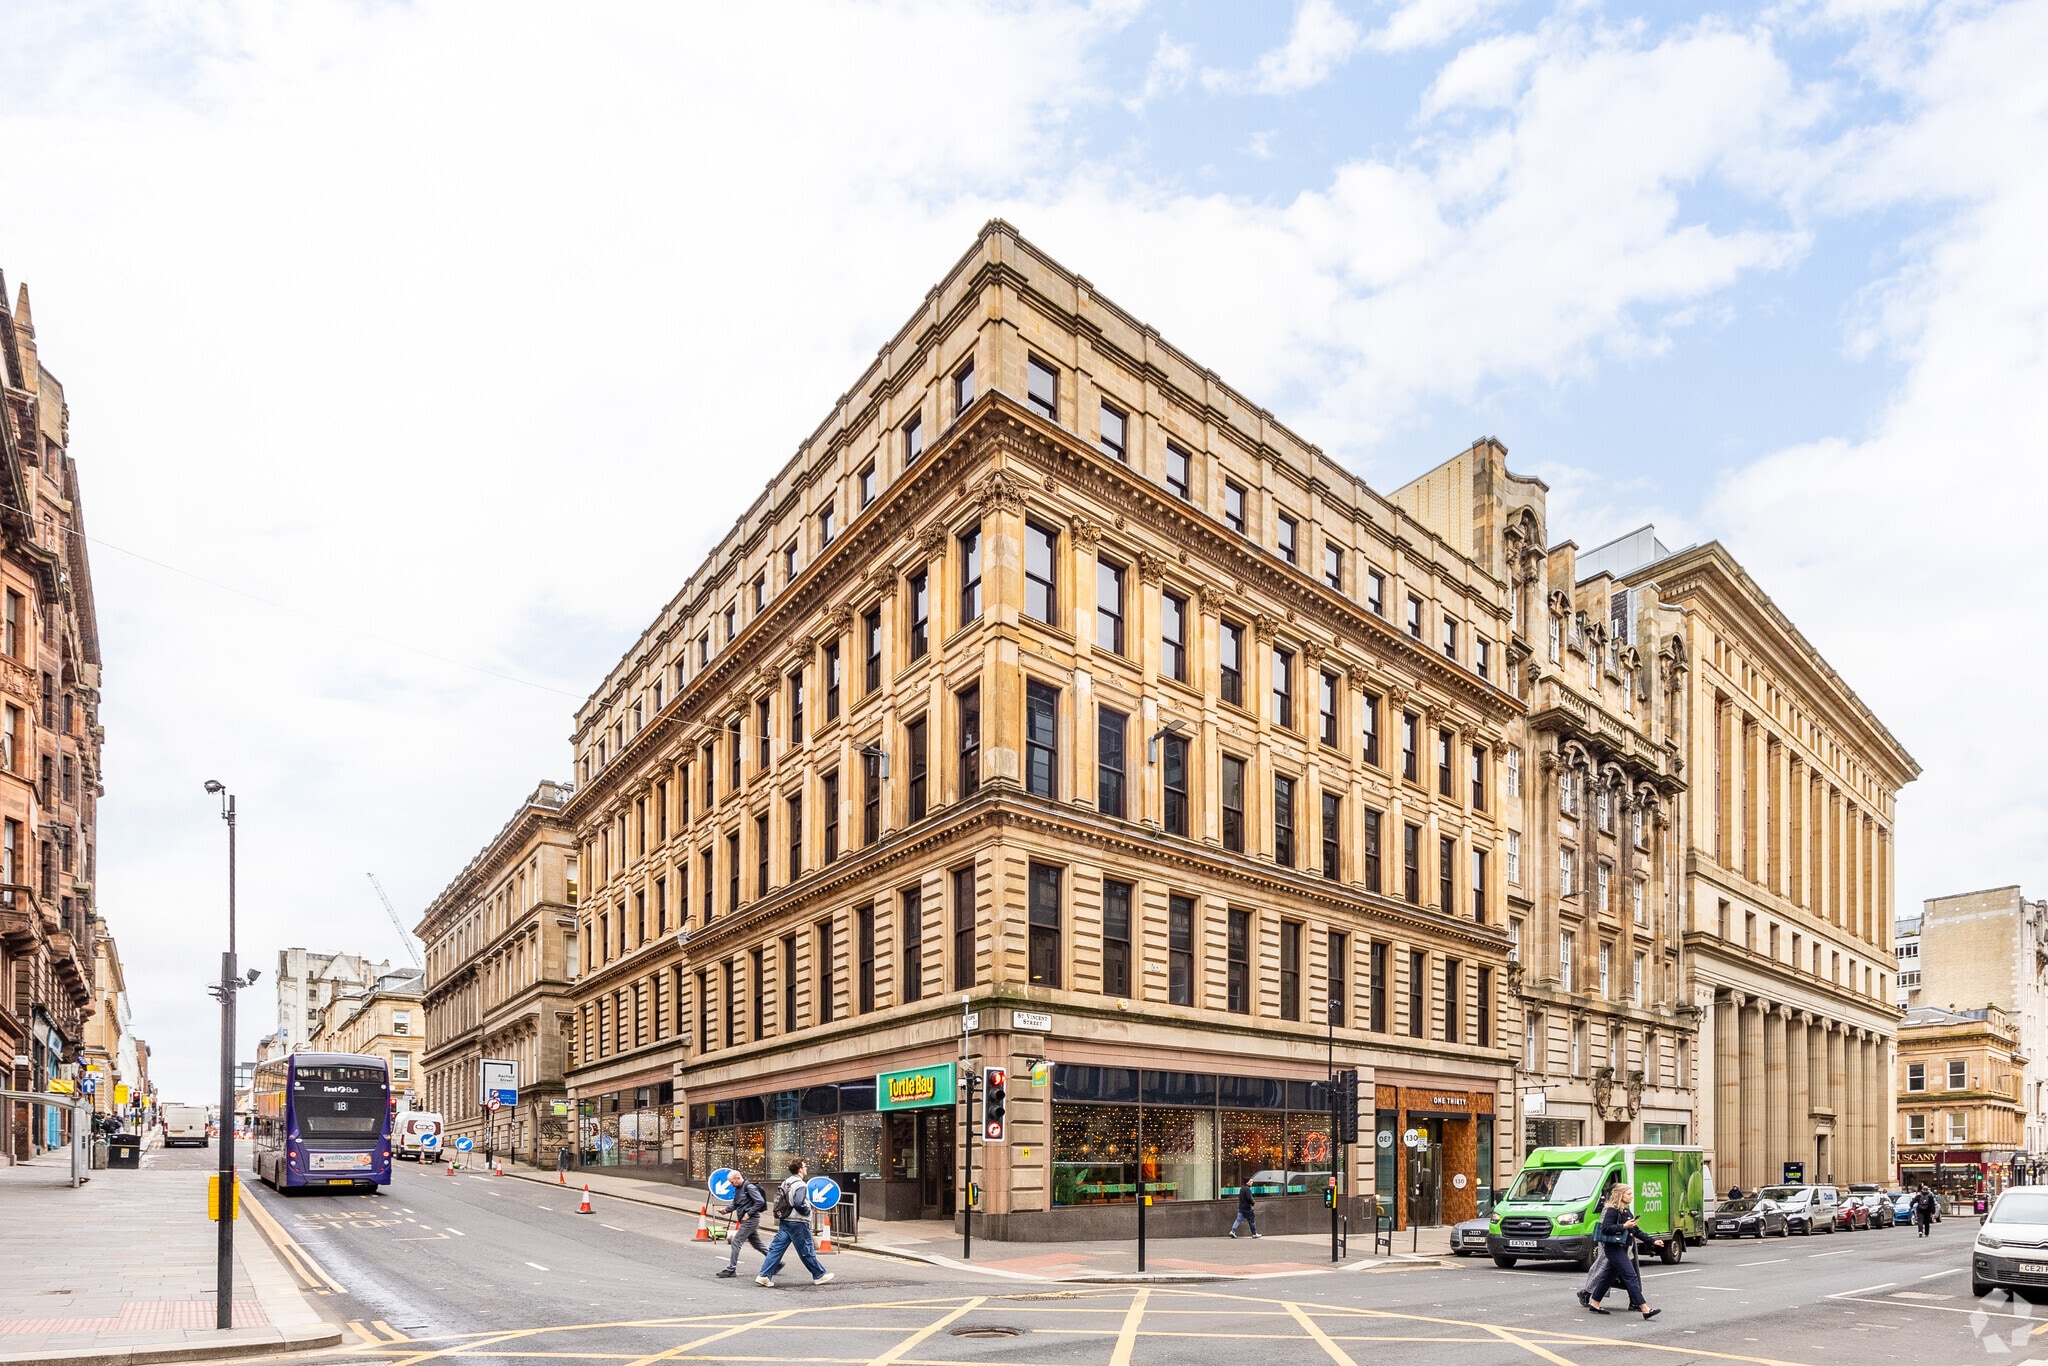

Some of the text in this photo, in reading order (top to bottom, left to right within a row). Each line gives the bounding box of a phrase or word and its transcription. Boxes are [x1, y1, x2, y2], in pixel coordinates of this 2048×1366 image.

[888, 1074, 934, 1097] Turtle Bay
[337, 1102, 346, 1110] 18
[1644, 1200, 1662, 1212] .com
[294, 1212, 377, 1220] BUS
[293, 1220, 403, 1229] STOP
